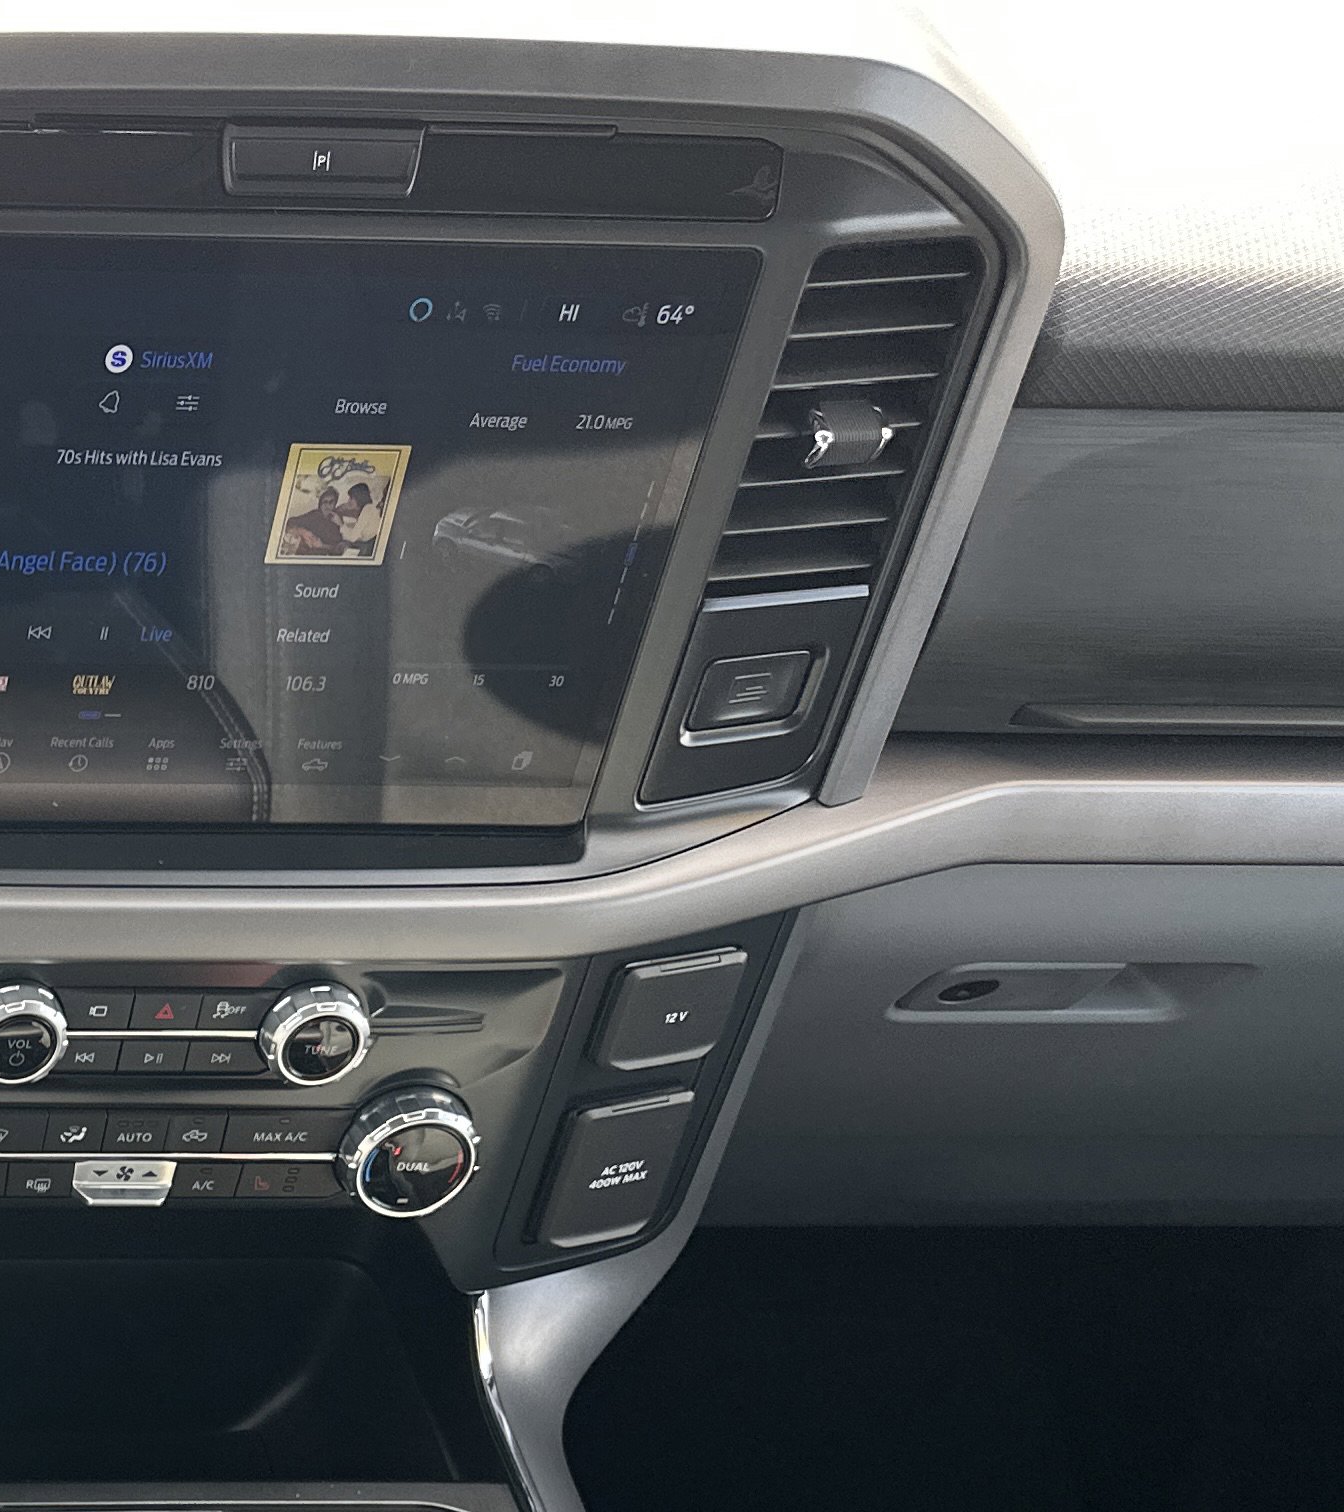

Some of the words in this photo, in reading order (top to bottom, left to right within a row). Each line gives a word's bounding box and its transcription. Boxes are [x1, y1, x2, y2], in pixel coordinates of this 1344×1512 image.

[559, 304, 580, 323] HI
[656, 303, 696, 325] 64°
[140, 351, 213, 370] SiriusXM
[512, 354, 547, 373] Fuel
[550, 355, 627, 375] Economy
[335, 398, 387, 416] Browse
[470, 413, 528, 431] Average
[575, 414, 605, 431] 21.0
[605, 416, 633, 430] MPG
[56, 449, 82, 466] 70s
[84, 450, 113, 466] Hits
[116, 449, 148, 466] with
[150, 451, 178, 467] Lisa
[180, 452, 223, 468] Evans
[59, 551, 117, 574] Face)
[123, 551, 167, 575] (76)
[294, 583, 339, 599] Sound
[140, 627, 173, 643] Live
[276, 628, 331, 644] Related
[186, 674, 215, 691] 810
[285, 675, 327, 692] 106.3
[393, 673, 401, 686] 0
[403, 673, 429, 686] MPG
[472, 674, 485, 687] 15
[549, 674, 564, 688] 30
[50, 736, 86, 749] Recent
[88, 736, 114, 749] Calls
[148, 737, 175, 751] Apps
[219, 737, 263, 751] Settings
[297, 738, 342, 751] Features
[228, 1005, 247, 1015] OFF
[8, 1039, 32, 1050] VOL
[304, 1045, 338, 1056] TUNE
[116, 1132, 152, 1143] AUTO
[253, 1132, 283, 1142] MAX
[284, 1132, 309, 1143] A/C
[396, 1162, 430, 1172] DUAL
[600, 1165, 617, 1177] AC
[618, 1160, 645, 1173] 120V
[192, 1180, 215, 1192] A/C
[589, 1176, 622, 1189] 400W
[622, 1170, 648, 1183] MAX
